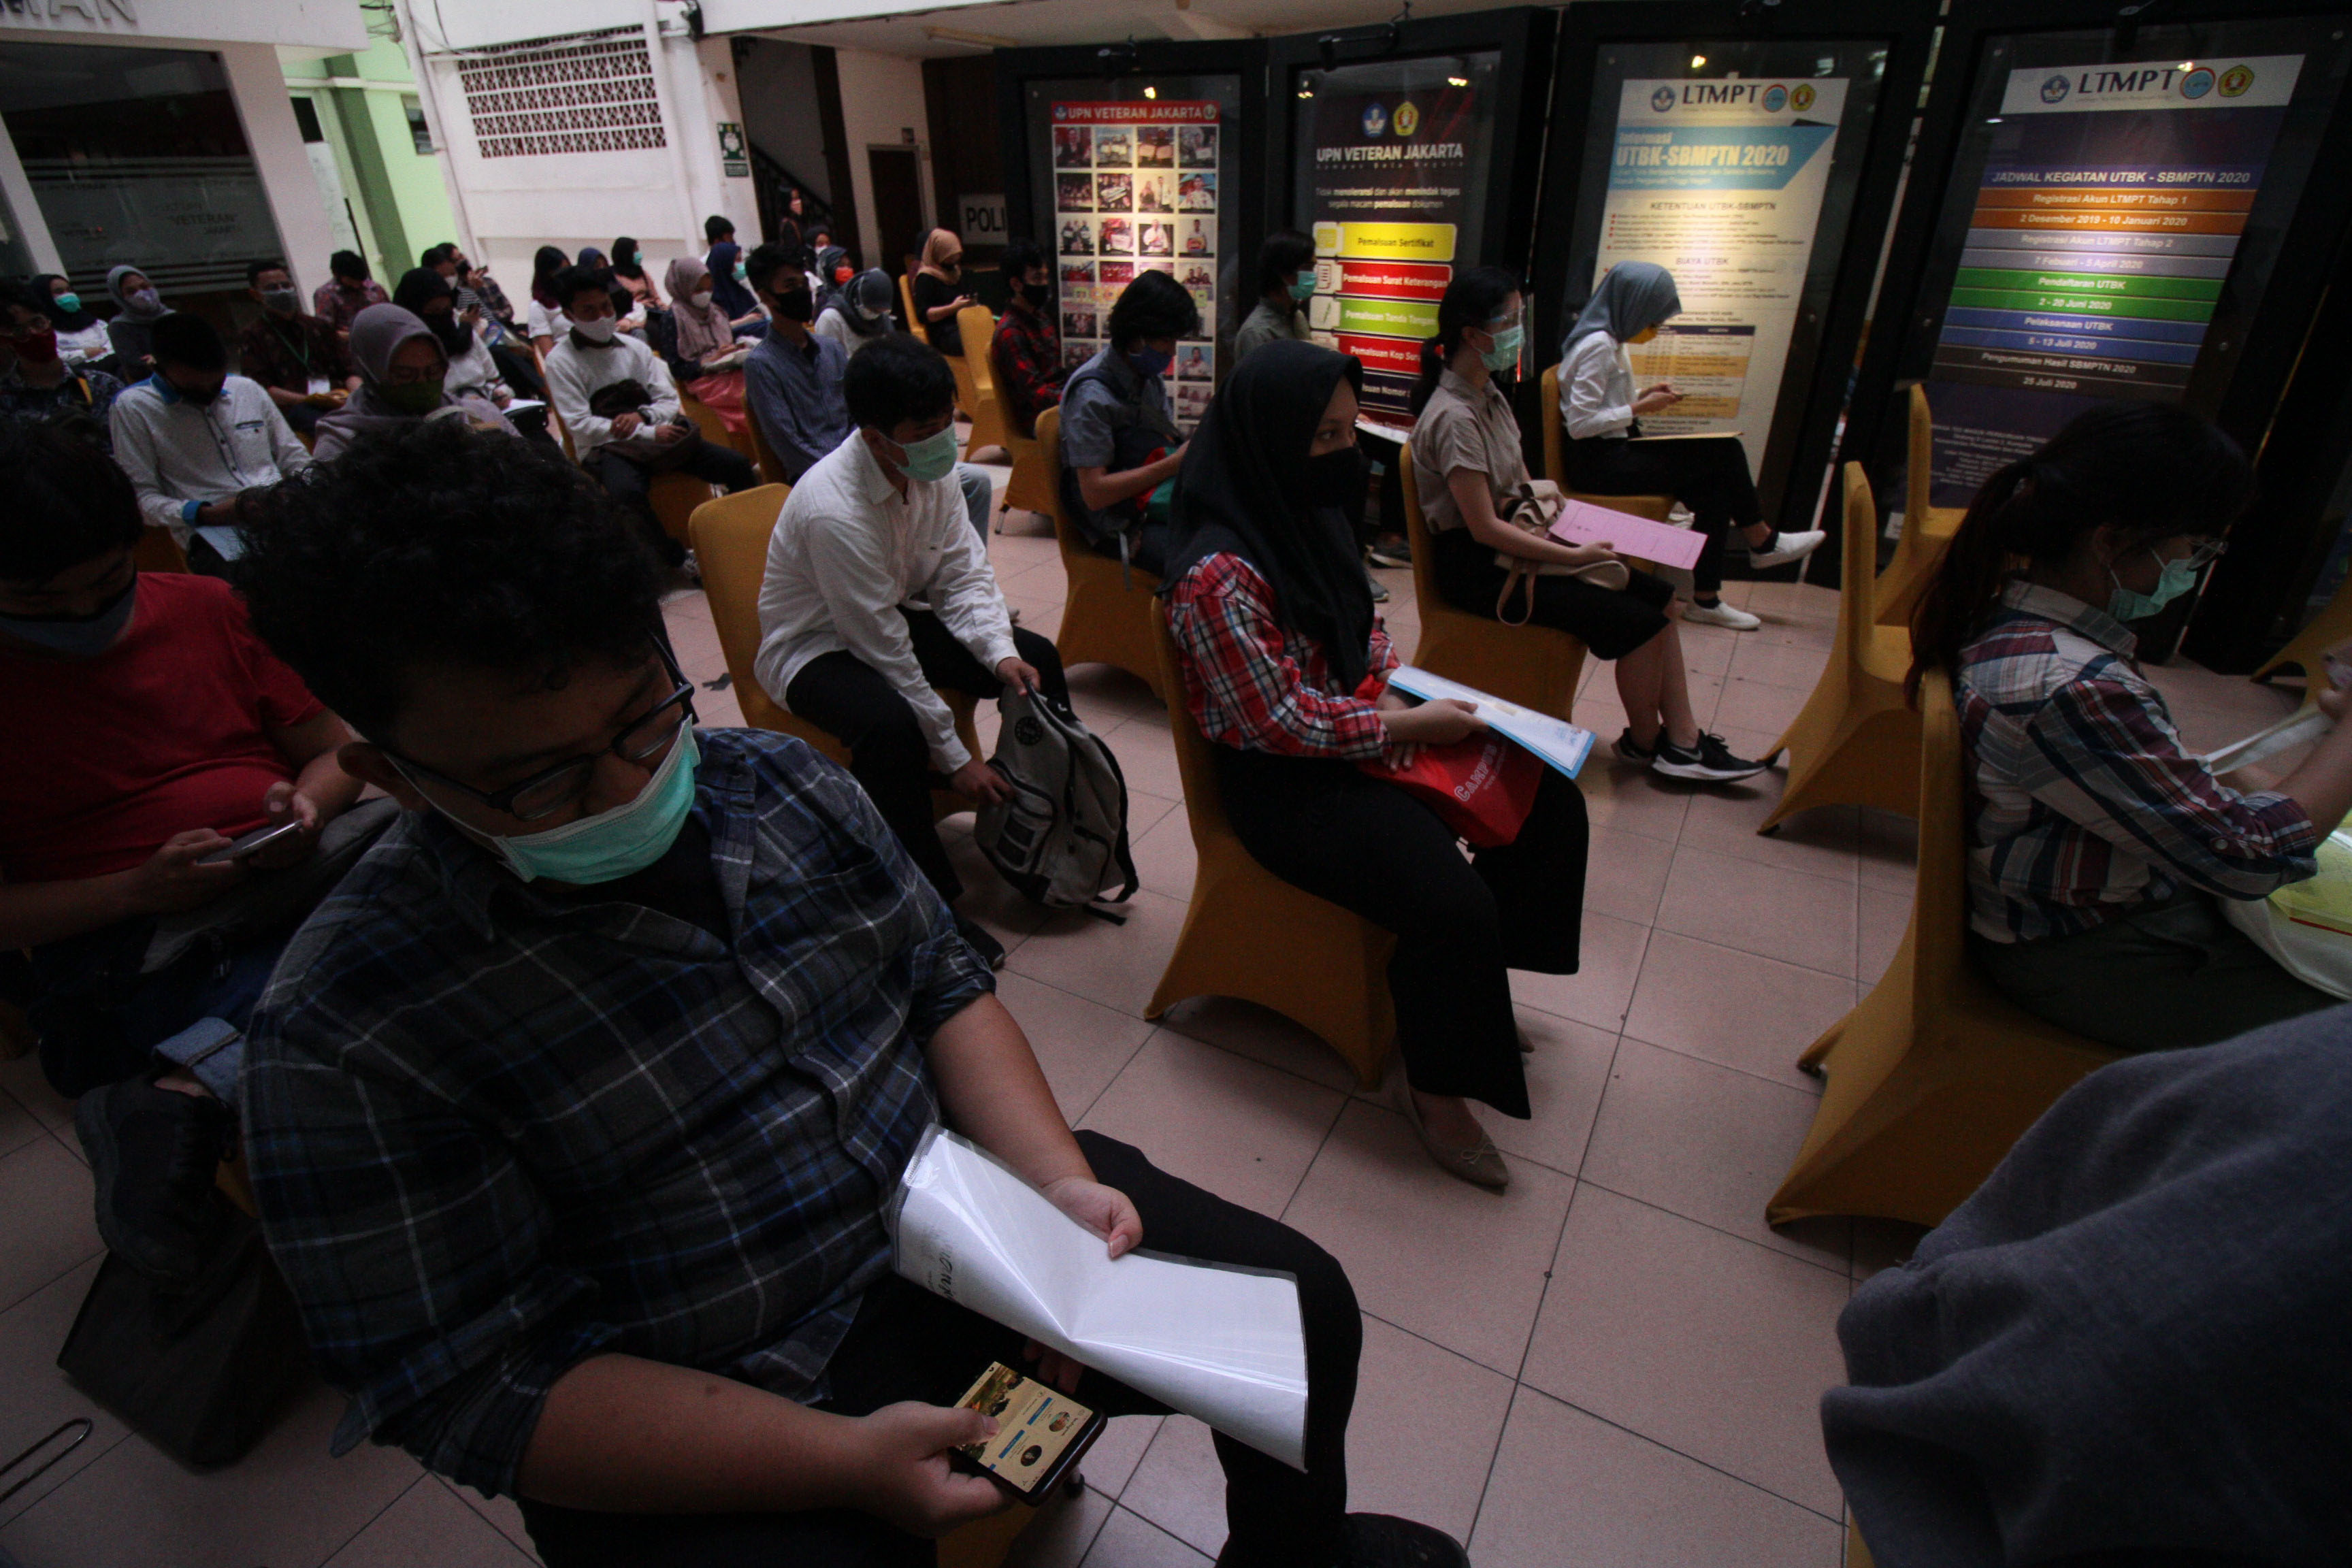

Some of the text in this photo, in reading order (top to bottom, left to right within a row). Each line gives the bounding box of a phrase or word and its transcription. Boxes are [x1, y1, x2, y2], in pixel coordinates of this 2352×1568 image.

[2078, 69, 2180, 95] LTMPT
[1682, 84, 1762, 103] LTMPT
[1068, 105, 1203, 119] UPN VETERAN JAKARTA
[1316, 143, 1463, 162] UPN VETERAN JAKARTA
[1617, 144, 1791, 167] UTBK-SBMPTN 2020
[1993, 172, 2041, 182] JADWAL
[2043, 172, 2108, 182] KEGIATAN
[2110, 172, 2147, 182] UTBK
[2157, 172, 2216, 183] SBMPTN
[2217, 172, 2251, 183] 2020
[2033, 194, 2187, 206] Registrasi Akun LTMPT Tahap 1
[2020, 214, 2026, 223] 2
[2028, 214, 2076, 223] Desember
[2076, 215, 2101, 224] 2019
[2110, 215, 2120, 225] 10
[2122, 216, 2161, 225] Januari
[2162, 217, 2188, 226] 2020
[1358, 238, 1434, 248] Pemalsuan Sertifikat
[1343, 274, 1448, 288] Pemalsuan Surat Keterangan
[2038, 277, 2127, 290] Pendaftaran UTBK
[2038, 297, 2045, 306] 2
[2088, 301, 2112, 310] 2020
[2085, 321, 2114, 331] UTBK
[2074, 340, 2097, 350] 2020
[1350, 346, 1388, 357] Pemalsuan
[1389, 350, 1405, 361] Kop
[2068, 360, 2111, 372] SBMPTN
[2112, 363, 2138, 374] 2020
[2055, 379, 2077, 389] 2020
